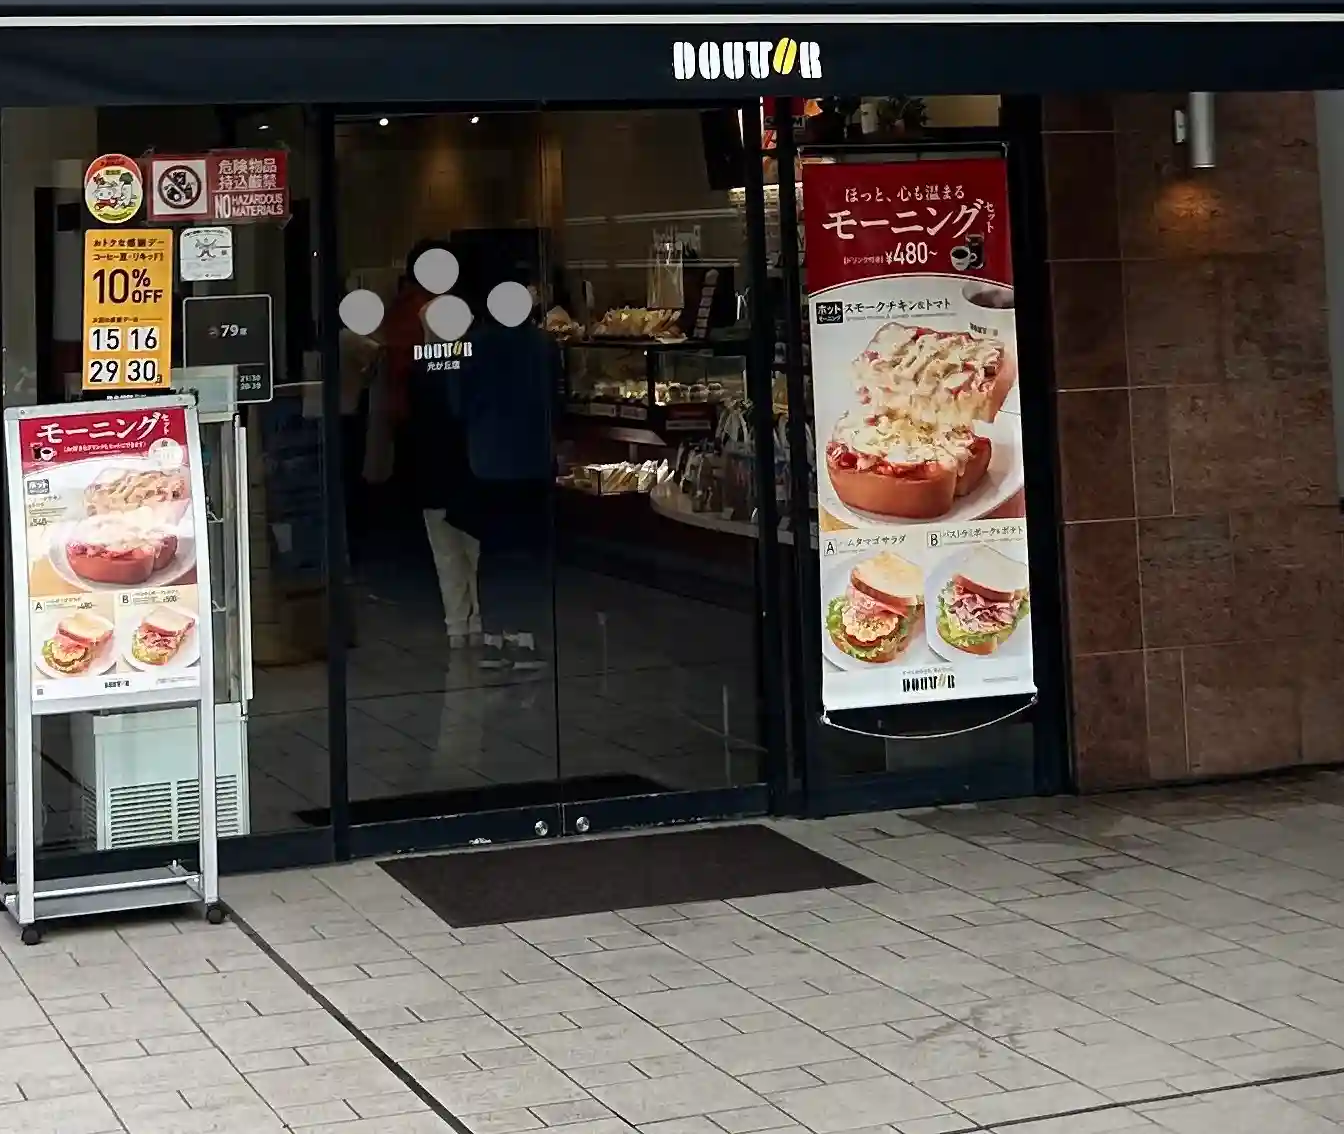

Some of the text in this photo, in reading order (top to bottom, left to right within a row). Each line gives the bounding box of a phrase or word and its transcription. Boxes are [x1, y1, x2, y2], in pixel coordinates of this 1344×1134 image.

[672, 36, 822, 80] DOUTOR
[218, 158, 277, 174] 危険物品
[214, 193, 283, 218] NO HAZARDOUS
[232, 204, 284, 216] MATERIALS
[822, 198, 984, 239] モーニング
[984, 202, 996, 233] セット
[132, 289, 163, 304] OFF
[817, 303, 842, 314] ホット
[92, 327, 157, 350] 15 16
[413, 340, 473, 360] DOUTOR
[89, 360, 119, 382] 29
[127, 360, 156, 382] 30
[36, 411, 161, 444] モーニング
[825, 541, 835, 554] A
[840, 533, 907, 547] ムタマゴサラダ
[930, 533, 939, 546] B
[35, 602, 43, 611] A
[122, 595, 129, 604] B
